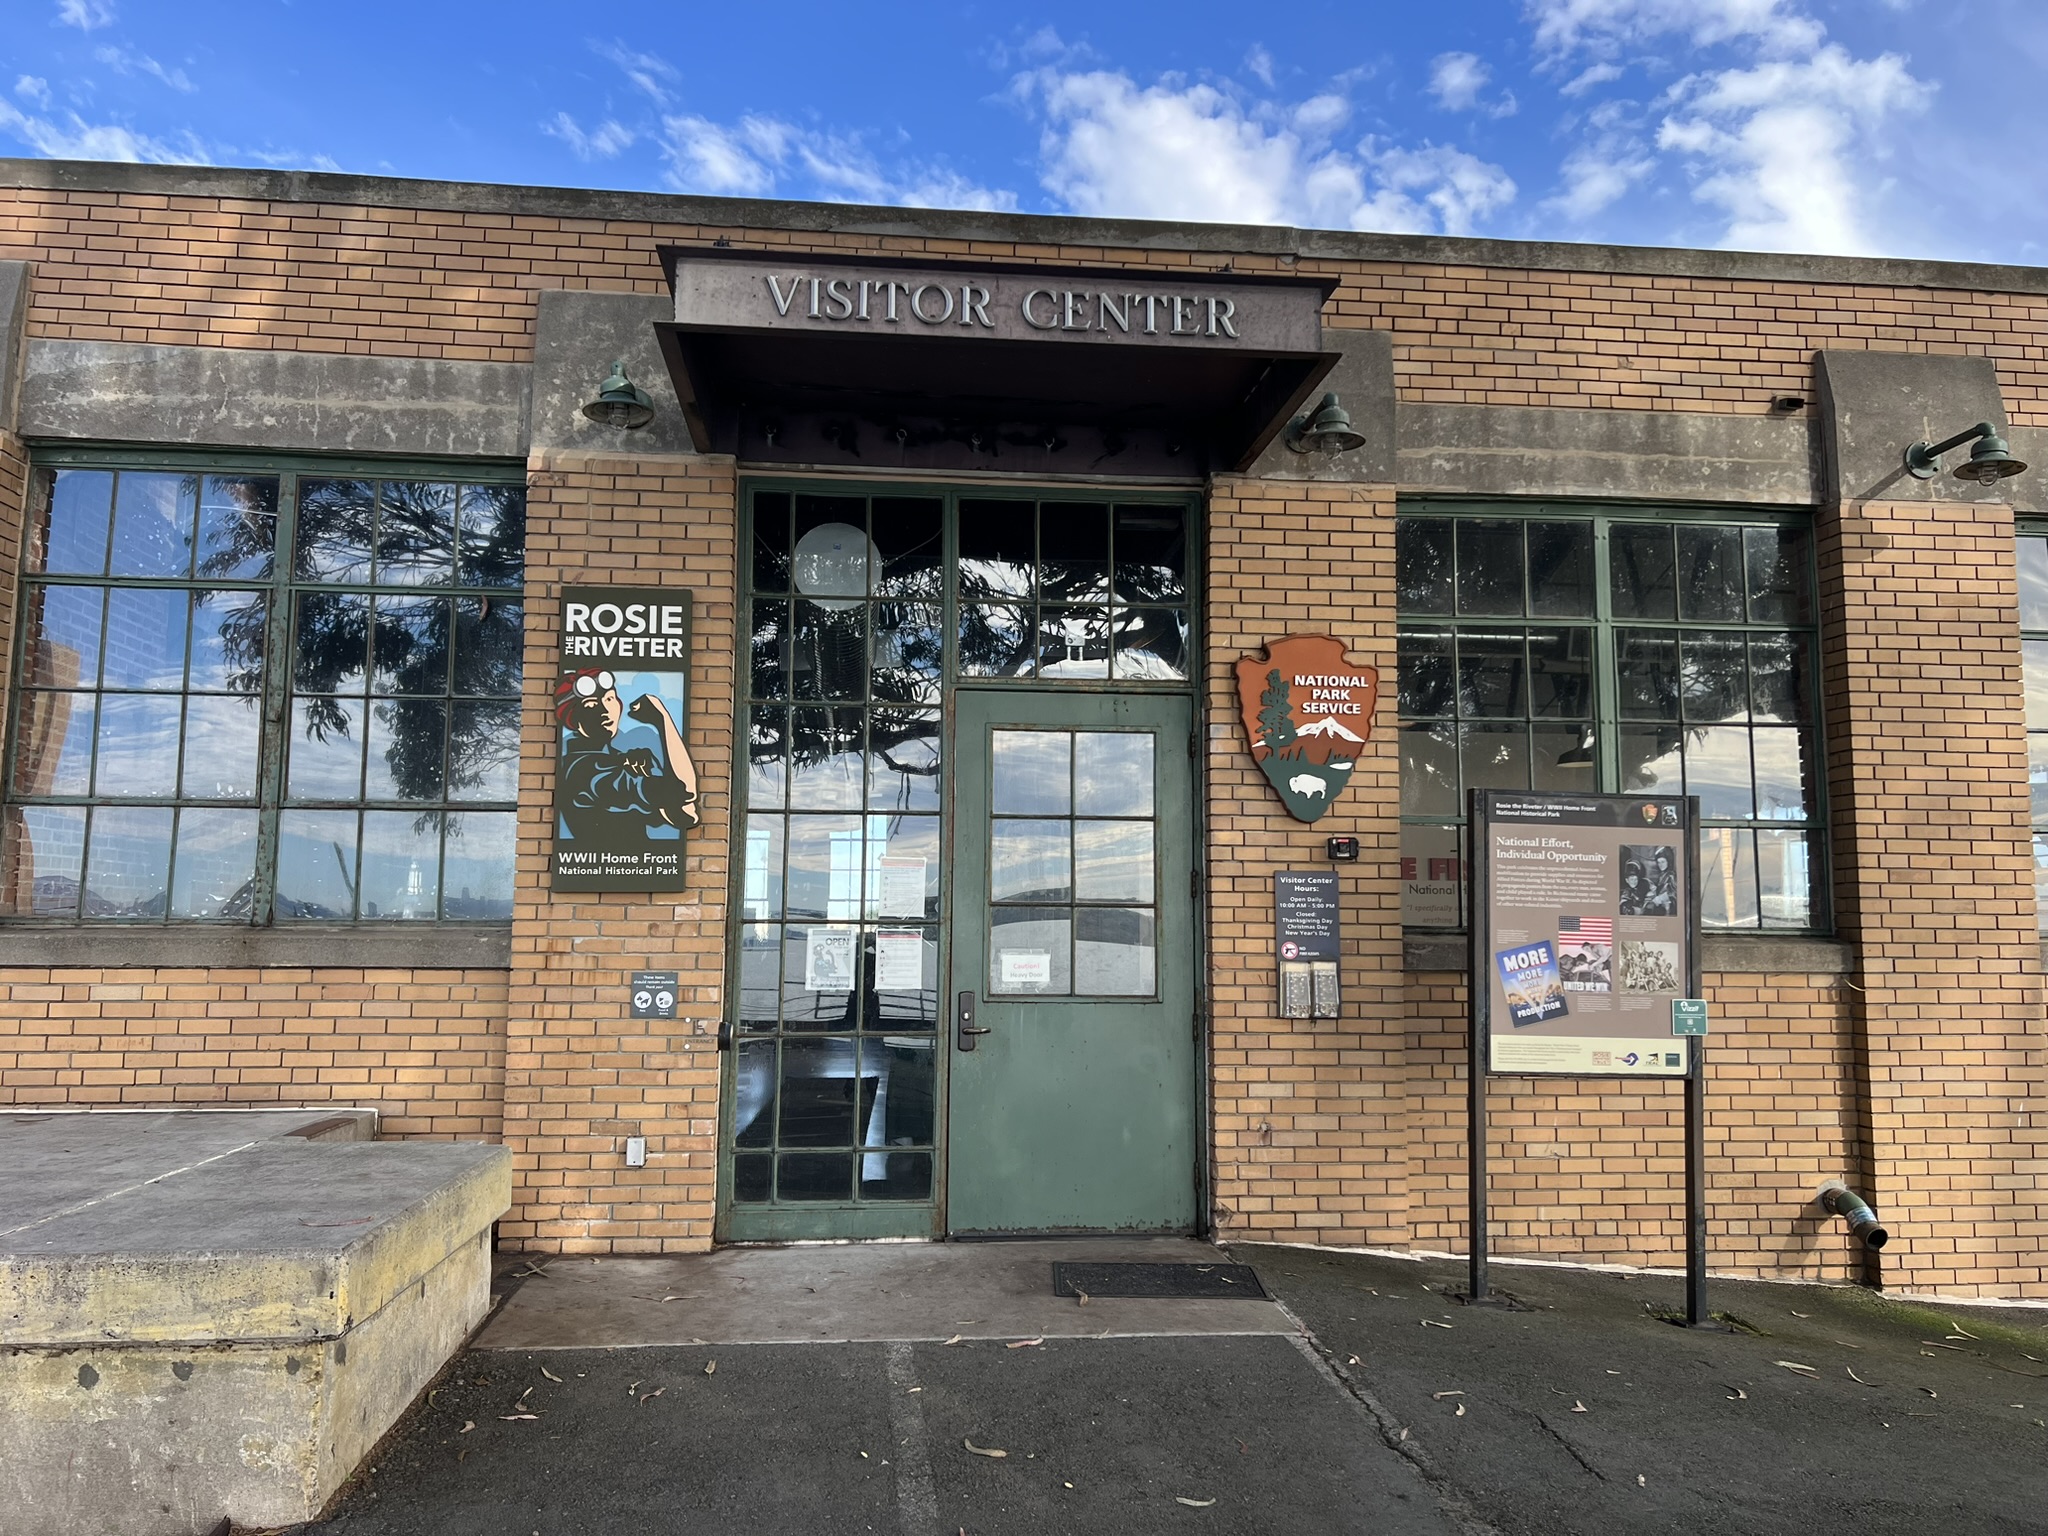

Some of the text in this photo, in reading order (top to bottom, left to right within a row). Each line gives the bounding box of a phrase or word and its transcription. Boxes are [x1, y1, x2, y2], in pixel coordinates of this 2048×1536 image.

[765, 274, 1240, 339] VISITOR CENTER
[566, 603, 683, 634] ROSIE
[565, 636, 684, 658] THE RIVETER
[1294, 675, 1368, 688] NATIONAL
[1312, 688, 1350, 701] PARK
[1302, 702, 1361, 715] SERVICE
[1496, 837, 1574, 848] National Effort,
[558, 852, 678, 864] WWII Home Front
[1496, 849, 1607, 864] Individual Opportunity
[559, 866, 678, 876] National Historical Park
[1409, 884, 1455, 894] National
[826, 938, 850, 946] OPEN
[1503, 948, 1549, 972] MORE
[1517, 968, 1543, 981] MORE
[1563, 981, 1584, 991] UNITED
[1585, 982, 1595, 991] WE
[1517, 1001, 1561, 1018] PRODUCTION
